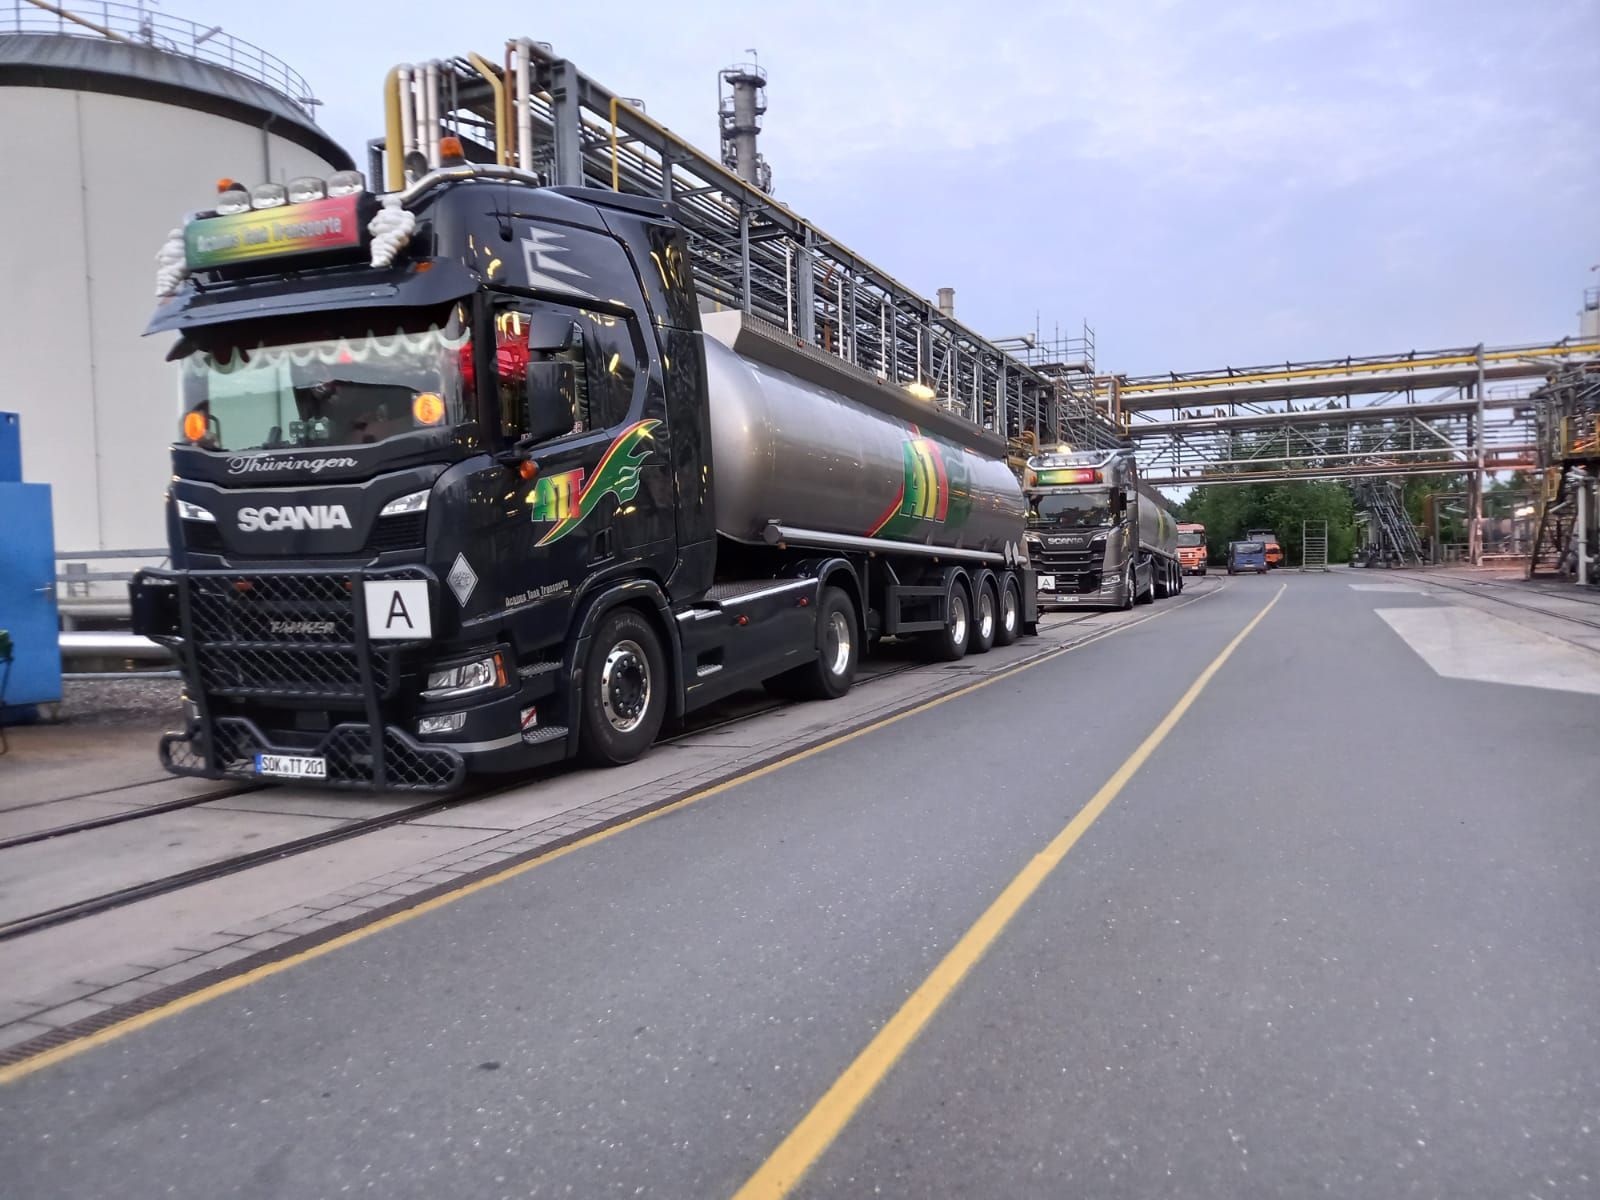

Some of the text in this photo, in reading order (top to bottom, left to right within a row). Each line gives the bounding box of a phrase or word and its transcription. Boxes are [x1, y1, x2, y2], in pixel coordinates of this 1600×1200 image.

[272, 216, 342, 242] Transporte
[226, 453, 358, 475] Thüringen
[531, 467, 585, 522] ATT
[237, 504, 353, 532] SCANIA
[1047, 537, 1083, 545] SCANIA
[1042, 578, 1051, 587] A
[385, 590, 414, 629] A
[262, 756, 325, 775] SOK TT 201
